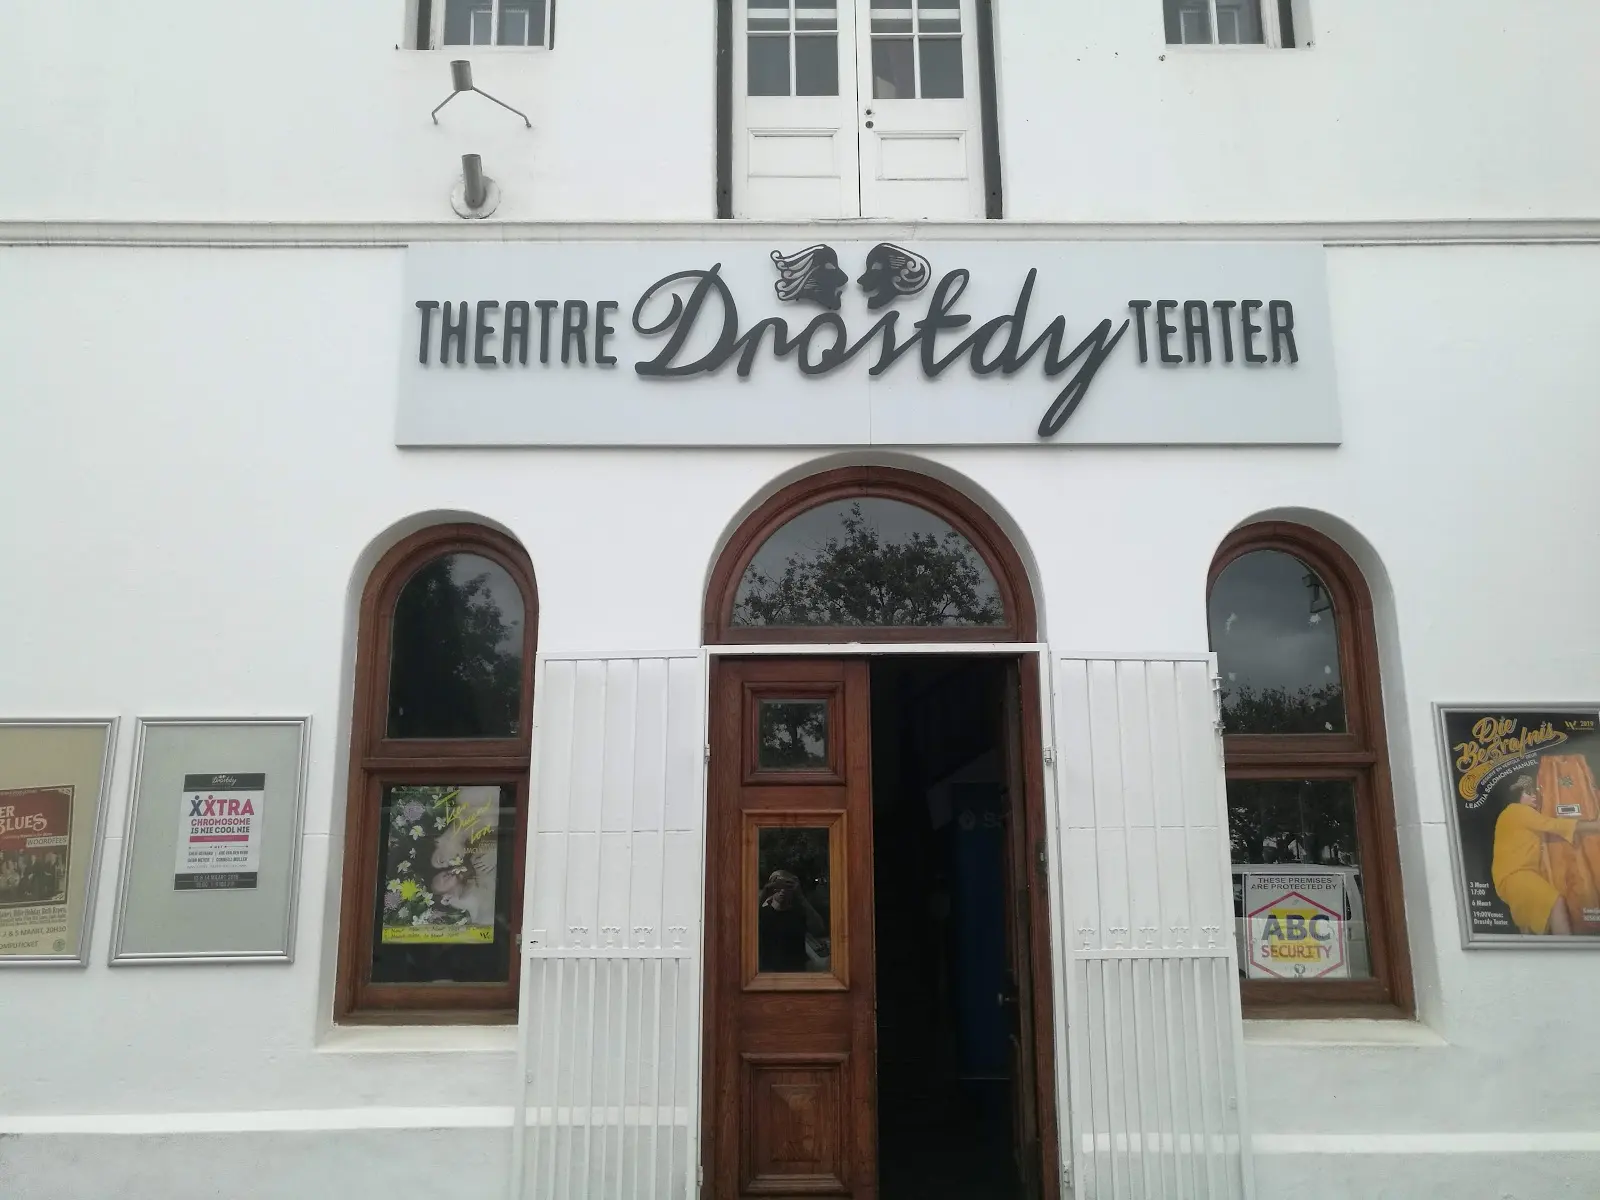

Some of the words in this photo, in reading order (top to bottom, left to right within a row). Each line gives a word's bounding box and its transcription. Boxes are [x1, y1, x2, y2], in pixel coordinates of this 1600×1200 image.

[415, 298, 619, 368] THEATRE
[633, 262, 1131, 437] Drostdy
[1127, 298, 1299, 366] TEATER
[1472, 716, 1517, 744] Die
[1453, 721, 1562, 772] Begrafnis
[1485, 768, 1513, 794] SOLOMONS
[1512, 759, 1538, 772] MANUEL
[191, 818, 251, 827] CHROMOSOME
[200, 826, 213, 834] NIE
[27, 836, 67, 846] WOORDFEES
[1262, 914, 1331, 942] ABC
[1261, 944, 1332, 959] SECURITY
